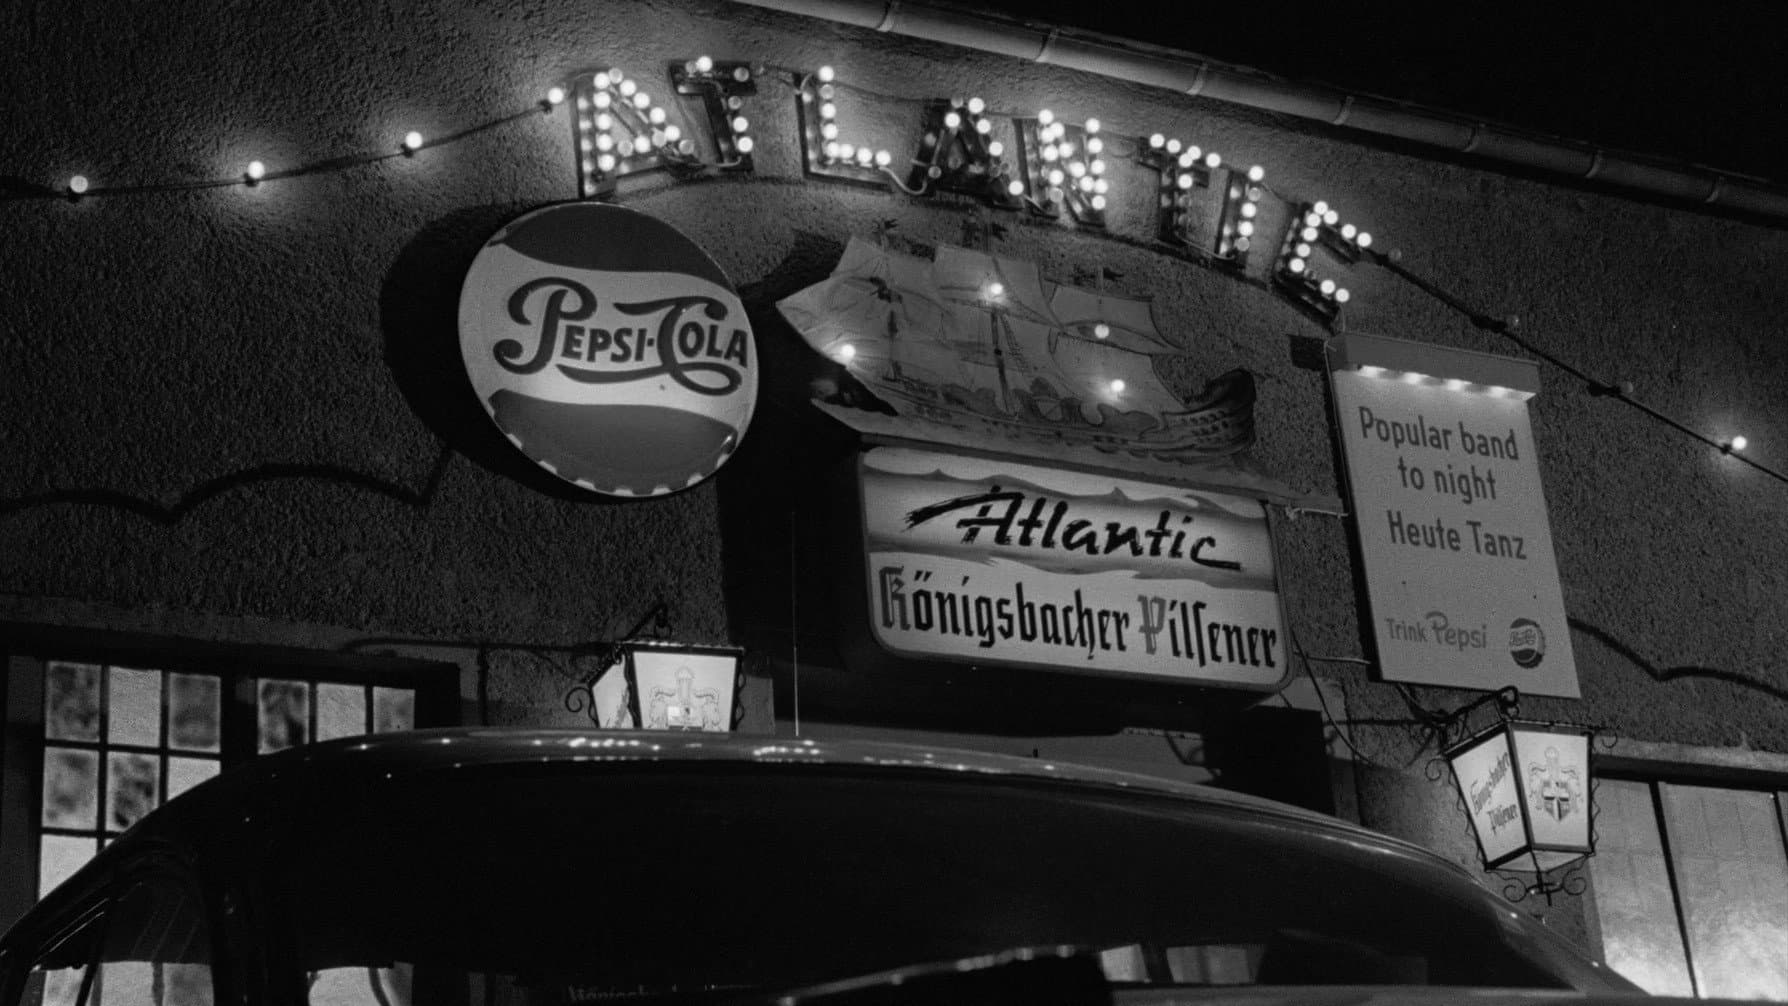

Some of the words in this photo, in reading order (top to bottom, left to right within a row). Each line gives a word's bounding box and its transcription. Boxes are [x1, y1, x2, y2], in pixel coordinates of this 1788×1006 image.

[570, 57, 1373, 318] ATLANTIC
[1358, 405, 1453, 451] Popular
[1458, 420, 1520, 461] band
[1398, 456, 1425, 491] to
[1433, 463, 1498, 505] night
[901, 485, 1242, 572] Atlantic
[1386, 509, 1462, 552] Heute
[1466, 519, 1528, 561] Tanz
[878, 565, 1131, 661] Königsbacher
[1384, 617, 1427, 642] Trink
[1424, 610, 1487, 652] Pepsi
